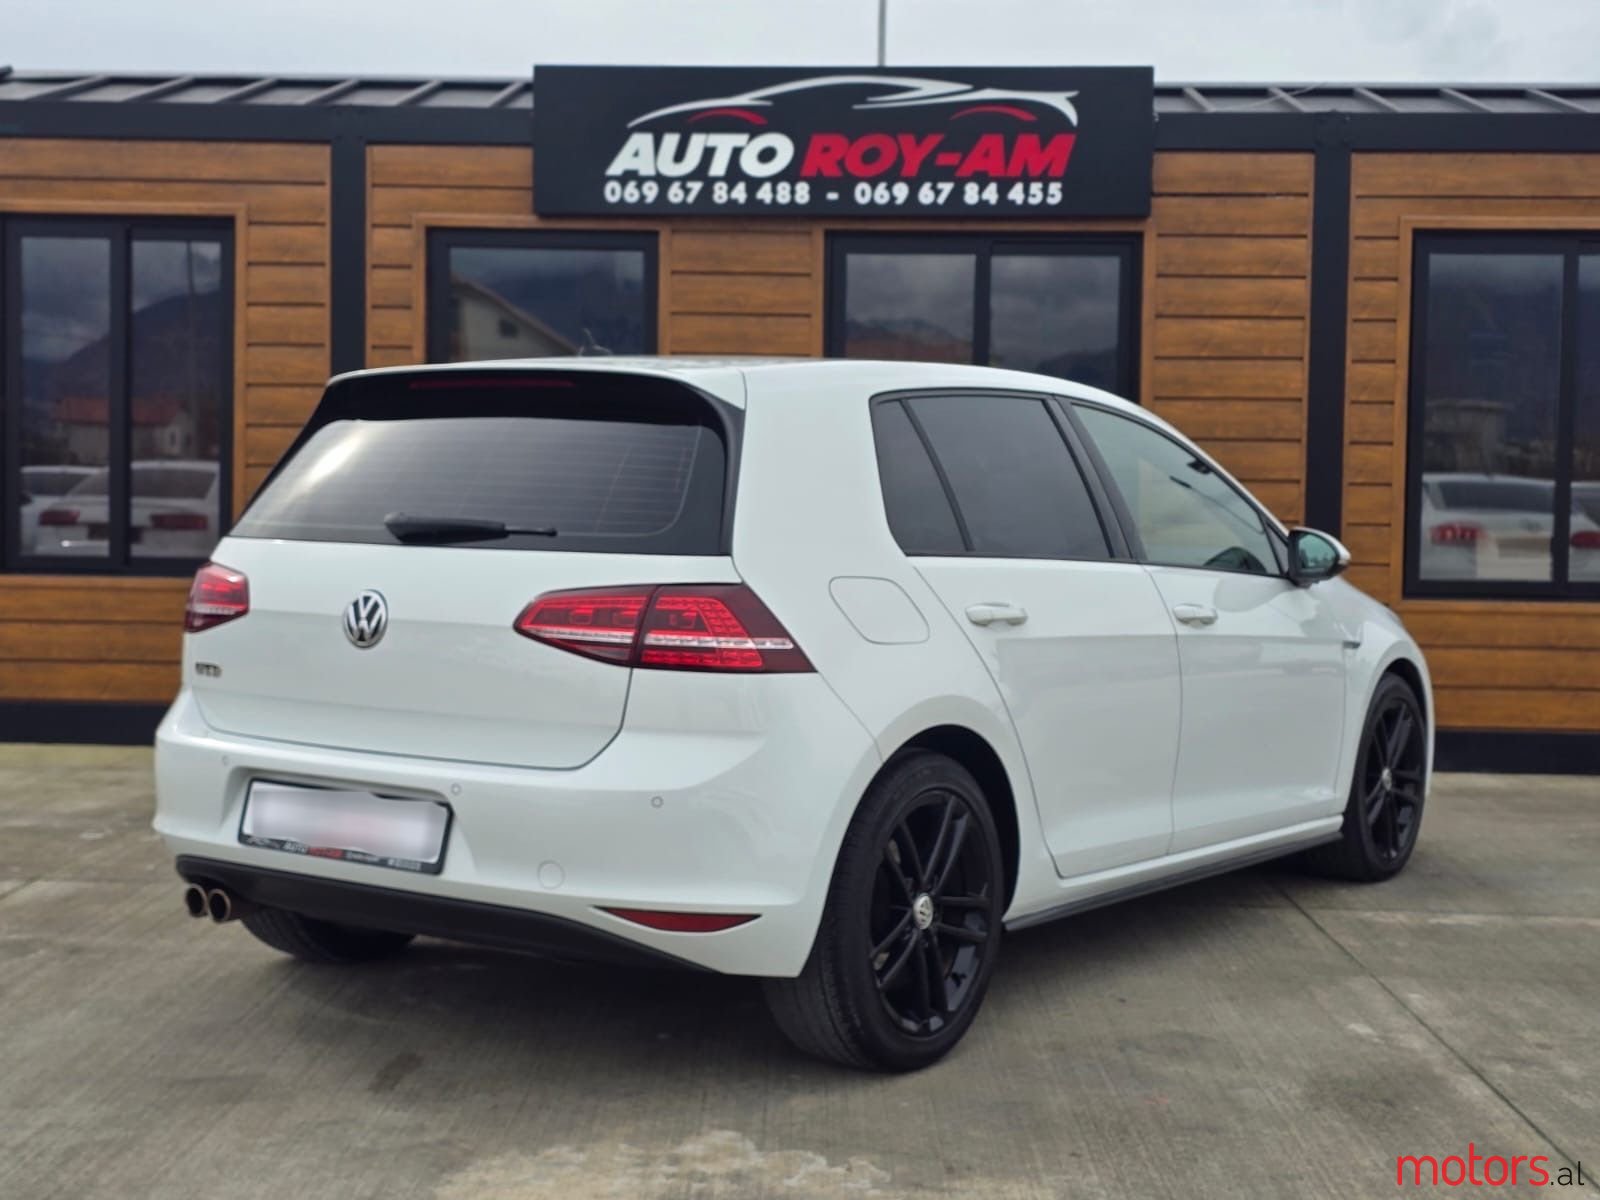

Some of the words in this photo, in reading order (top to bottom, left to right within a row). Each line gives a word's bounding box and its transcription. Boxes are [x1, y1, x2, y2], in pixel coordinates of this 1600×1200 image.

[605, 133, 795, 178] AUTO
[800, 133, 1077, 178] ROY-AM
[604, 181, 659, 205] 069
[668, 181, 703, 205] 67
[712, 181, 747, 205] 84
[756, 181, 811, 205] 488
[854, 181, 909, 205] 069
[918, 181, 953, 205] 67
[964, 181, 999, 205] 84
[1007, 181, 1063, 205] 455
